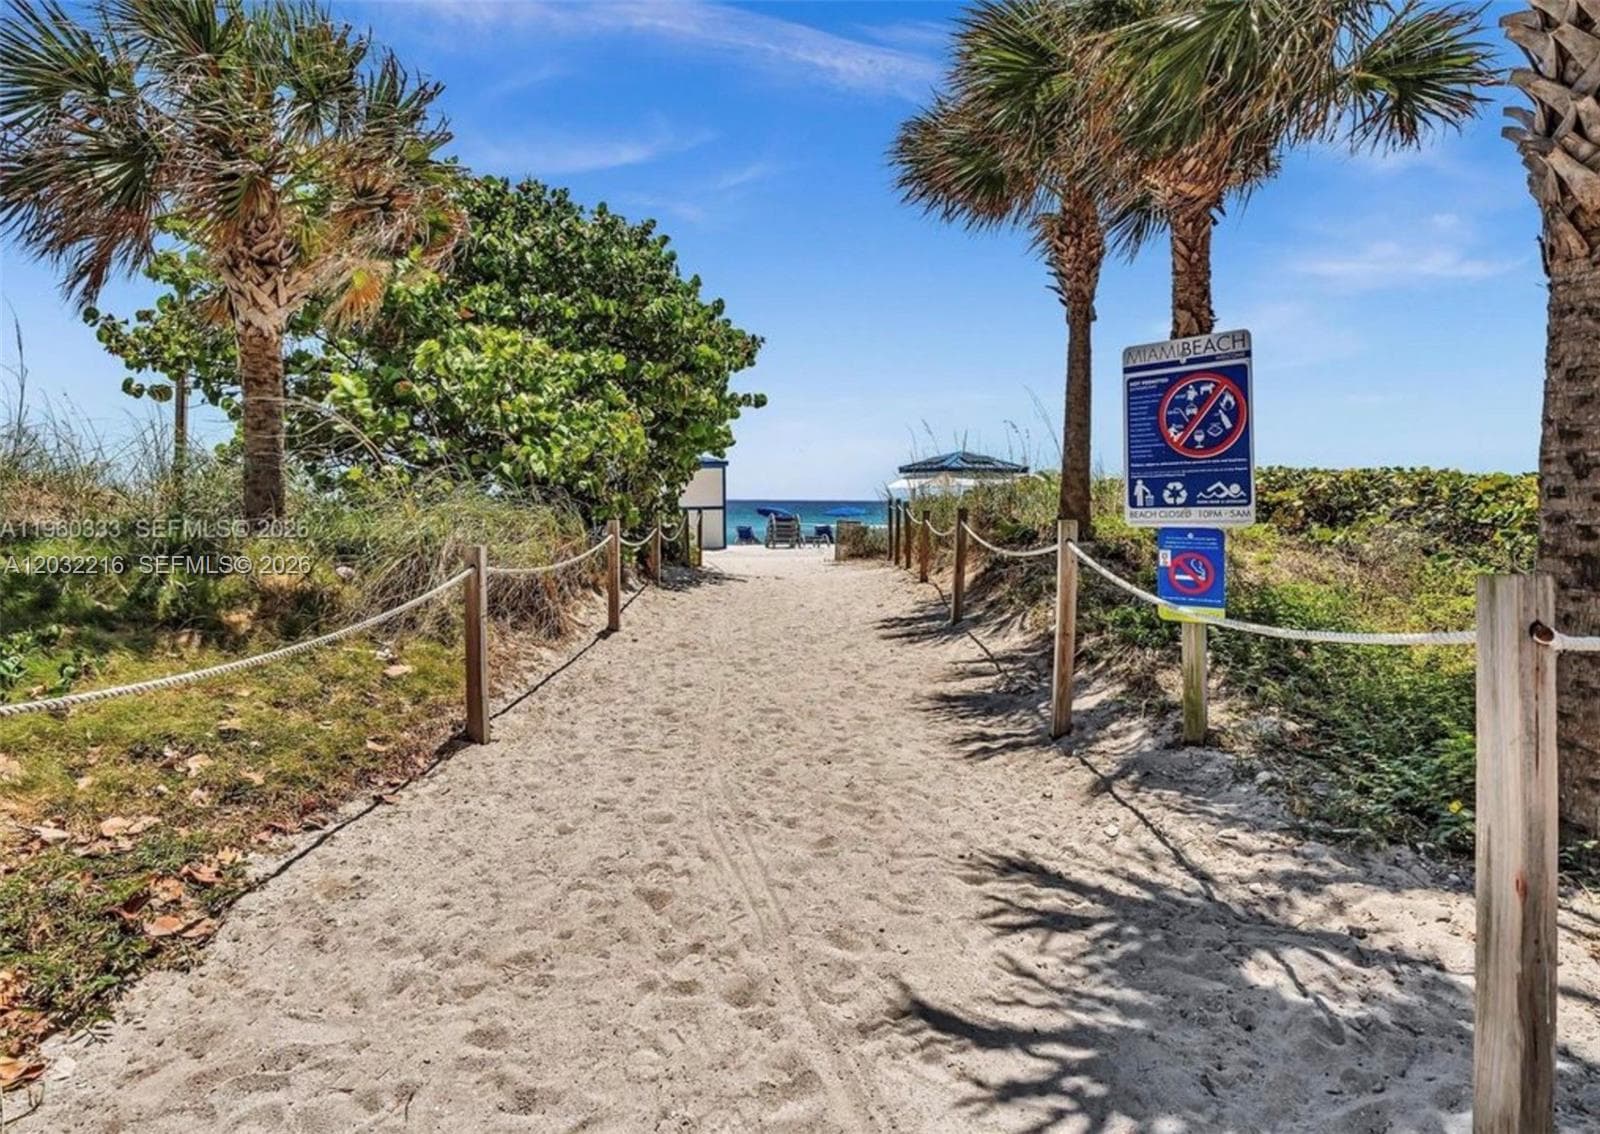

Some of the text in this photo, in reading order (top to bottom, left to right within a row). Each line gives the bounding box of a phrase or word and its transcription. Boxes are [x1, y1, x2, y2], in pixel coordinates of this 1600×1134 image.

[1129, 510, 1157, 519] BEACH
[1158, 509, 1192, 518] CLOSED
[1198, 509, 1223, 518] 10PM
[1230, 509, 1251, 518] 5AM
